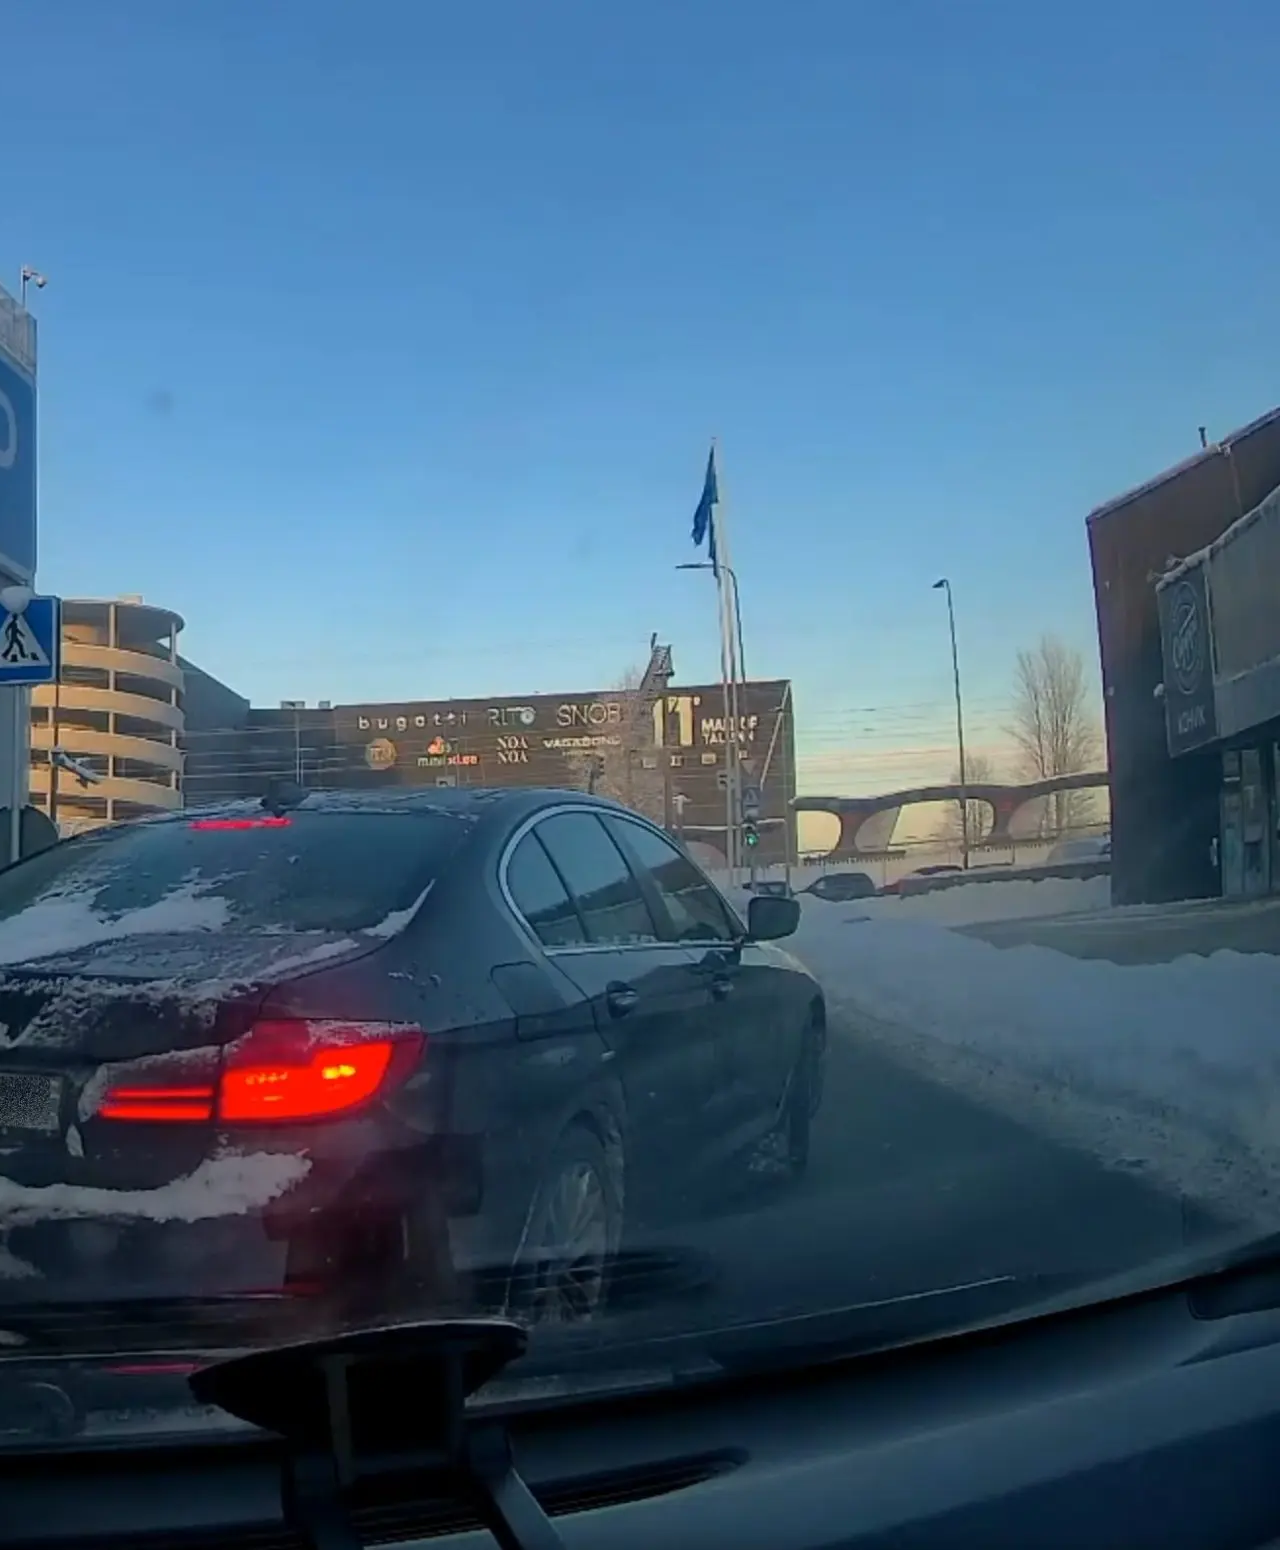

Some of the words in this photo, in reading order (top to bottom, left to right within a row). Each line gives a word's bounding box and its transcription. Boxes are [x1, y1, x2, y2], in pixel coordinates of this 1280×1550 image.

[358, 710, 467, 732] bugatti
[556, 703, 621, 726] SNOB
[496, 735, 529, 749] NOA
[496, 749, 529, 764] NOA
